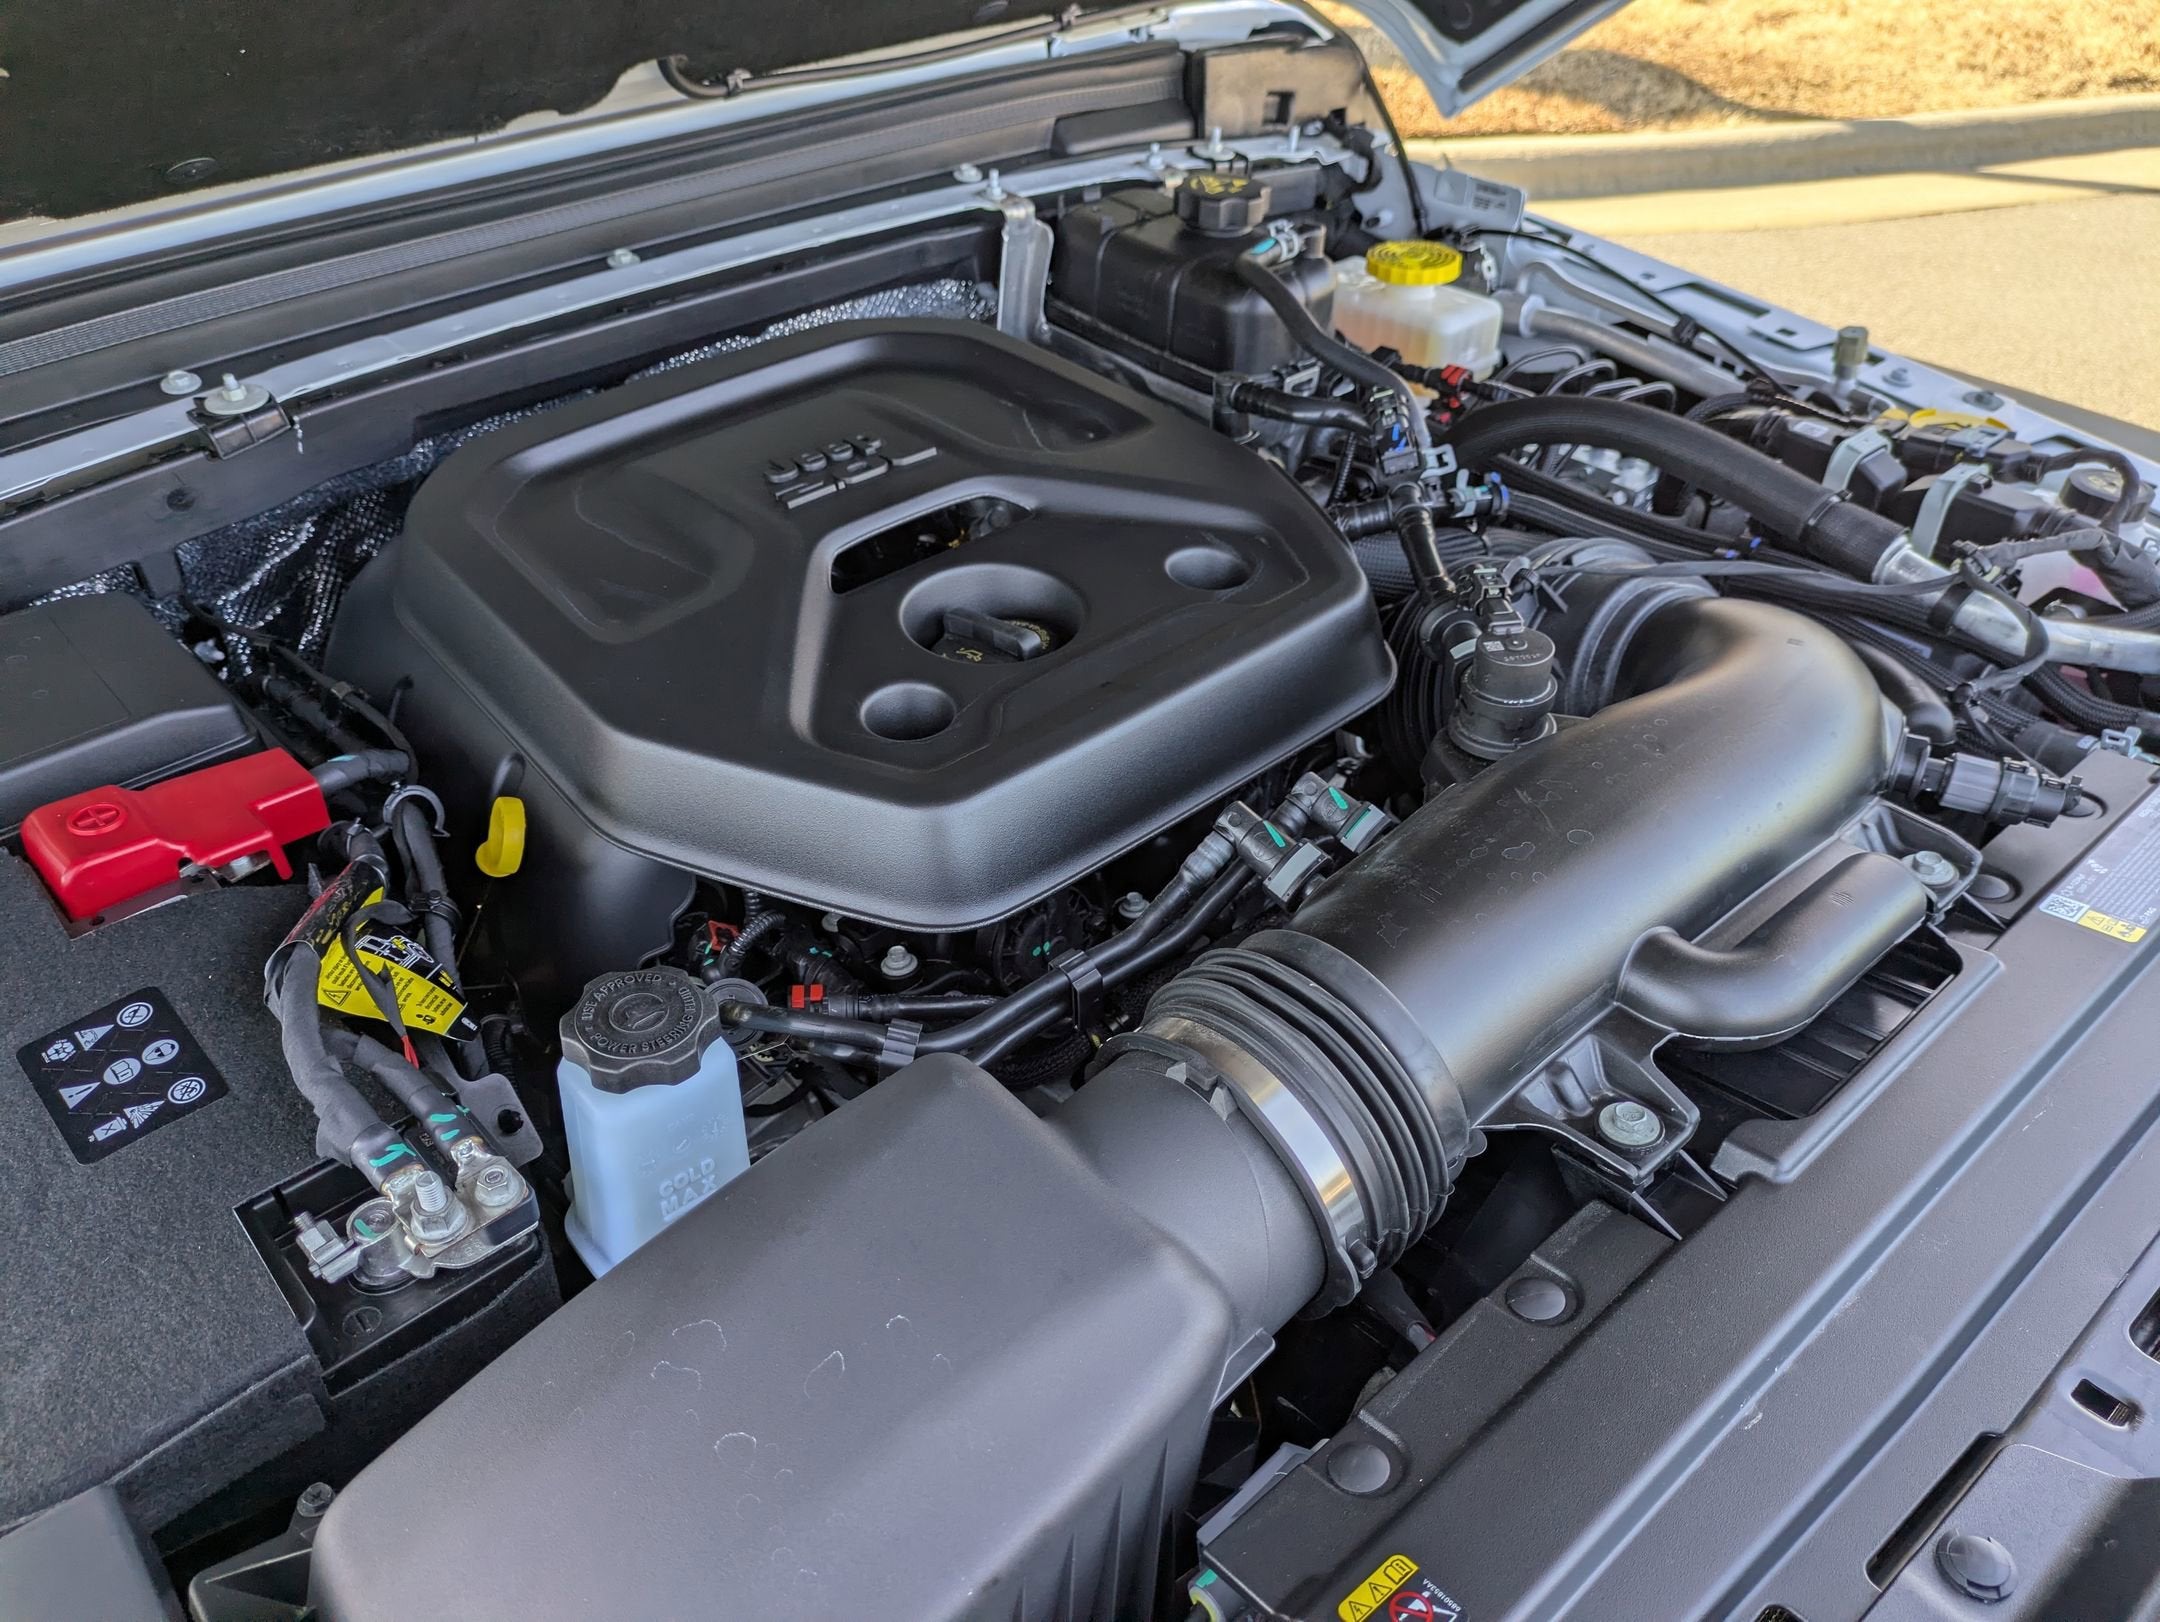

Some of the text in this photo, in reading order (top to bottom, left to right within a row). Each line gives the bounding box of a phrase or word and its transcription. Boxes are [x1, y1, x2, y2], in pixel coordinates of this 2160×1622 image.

[764, 433, 883, 483] Jeep
[775, 446, 938, 509] 2.0L
[581, 973, 662, 1021] USE APPROVED
[590, 986, 696, 1054] POWER STEERING FLUID
[660, 1158, 715, 1198] COLD
[661, 1174, 718, 1217] MAX
